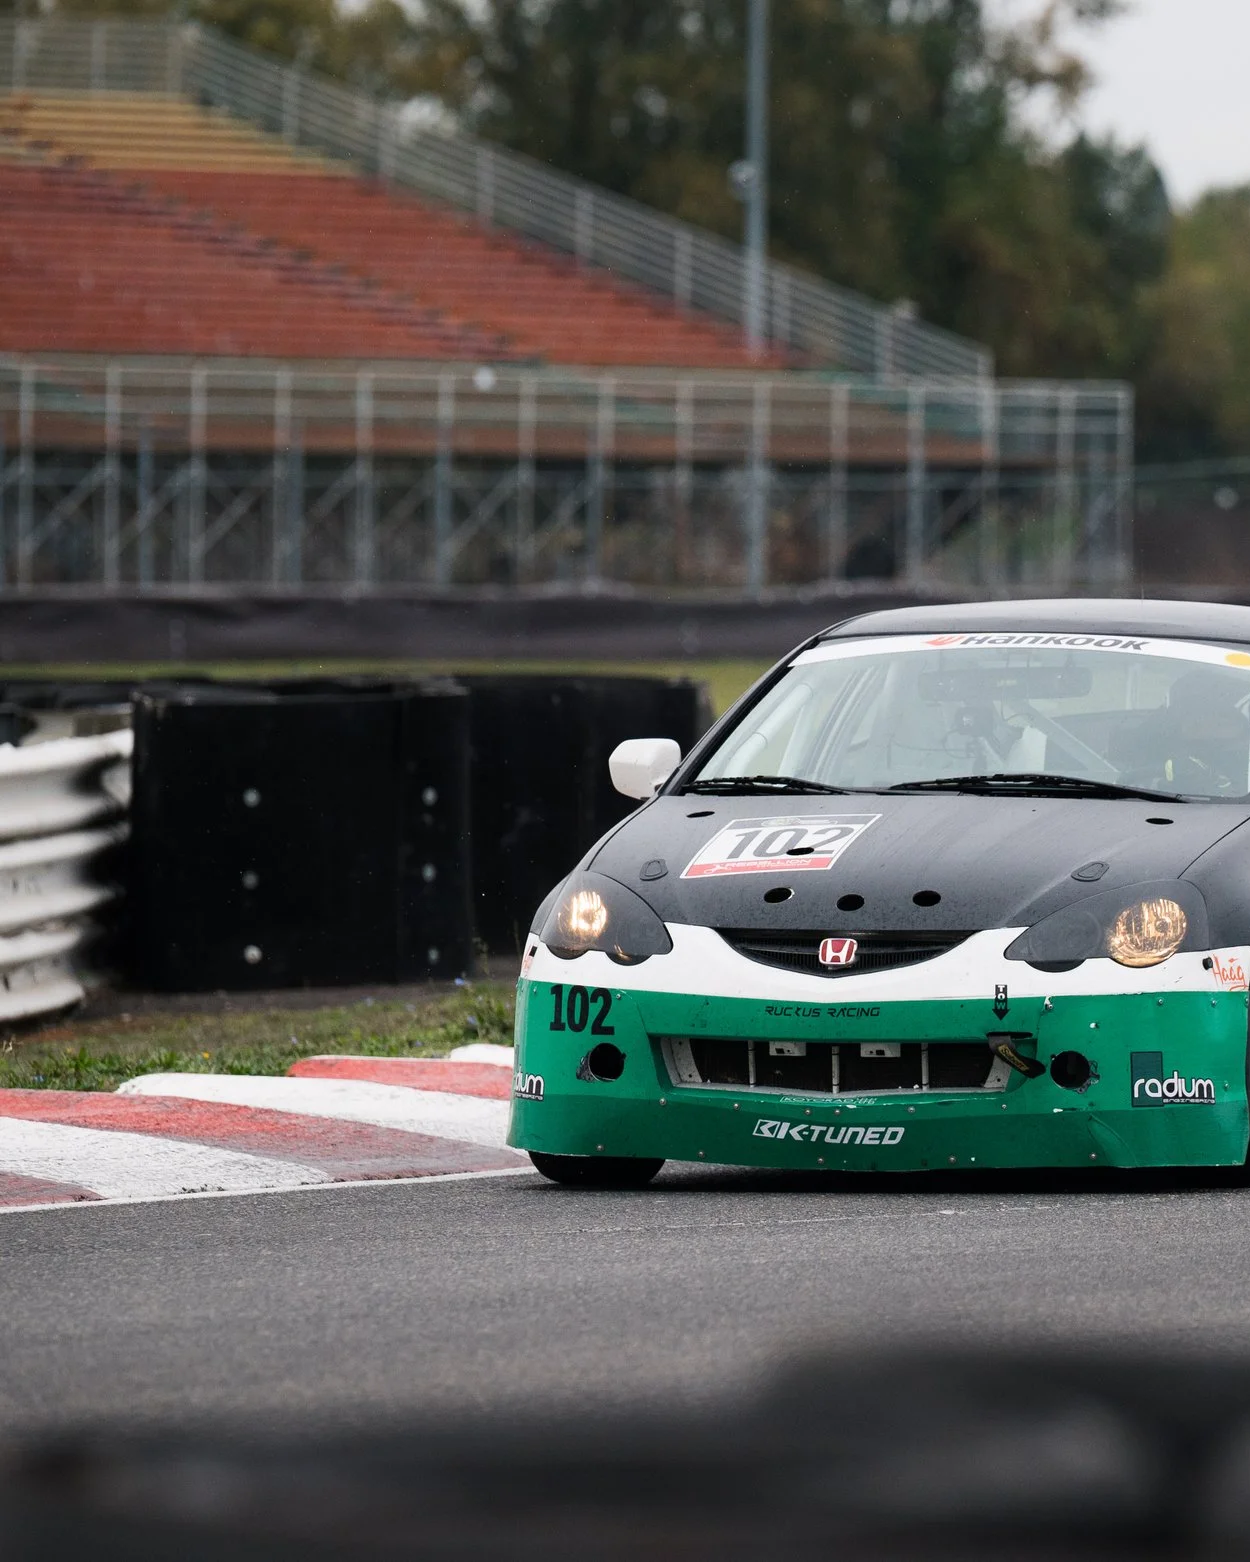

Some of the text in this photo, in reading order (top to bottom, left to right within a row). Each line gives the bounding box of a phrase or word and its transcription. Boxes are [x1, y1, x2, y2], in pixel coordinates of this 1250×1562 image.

[726, 827, 855, 860] 102
[549, 984, 615, 1036] 102
[996, 985, 1008, 1011] TOW
[765, 1006, 880, 1018] RUCKUS RACING
[515, 1066, 545, 1096] dium
[1134, 1071, 1215, 1098] radium
[777, 1121, 905, 1145] K-TUNED
